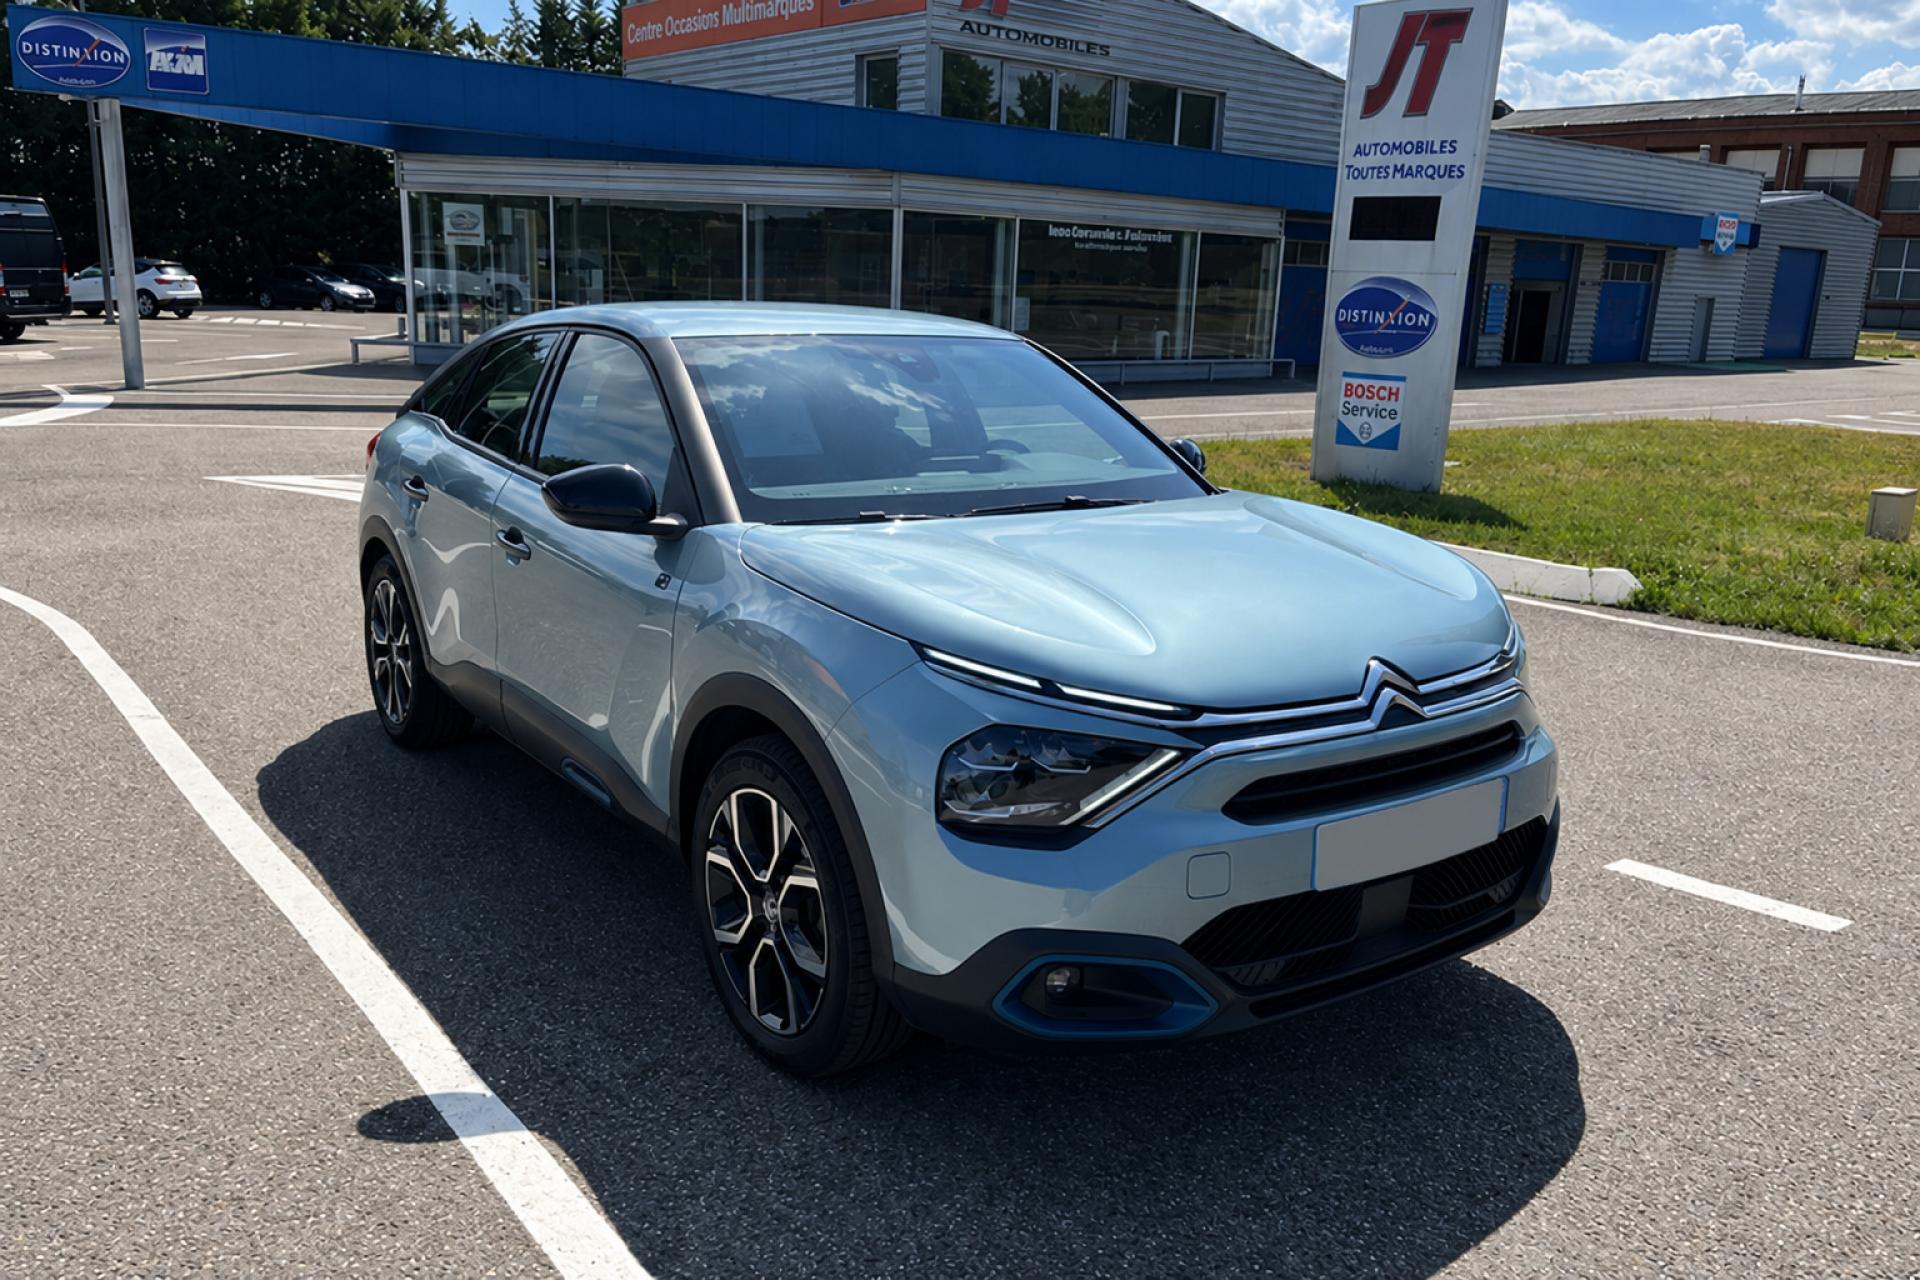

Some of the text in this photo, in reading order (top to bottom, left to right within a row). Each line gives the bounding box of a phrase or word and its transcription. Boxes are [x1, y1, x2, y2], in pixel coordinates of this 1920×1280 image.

[627, 0, 815, 44] Centre Occasions Multimarques
[959, 20, 1111, 57] AUTOMOBILES
[22, 41, 125, 64] DISTINXION
[1353, 140, 1458, 157] AUTOMOBILES
[1392, 164, 1465, 180] MARQUES
[1338, 309, 1430, 327] DISTINXION
[1343, 382, 1400, 402] BOSCH
[1341, 401, 1398, 420] Service
